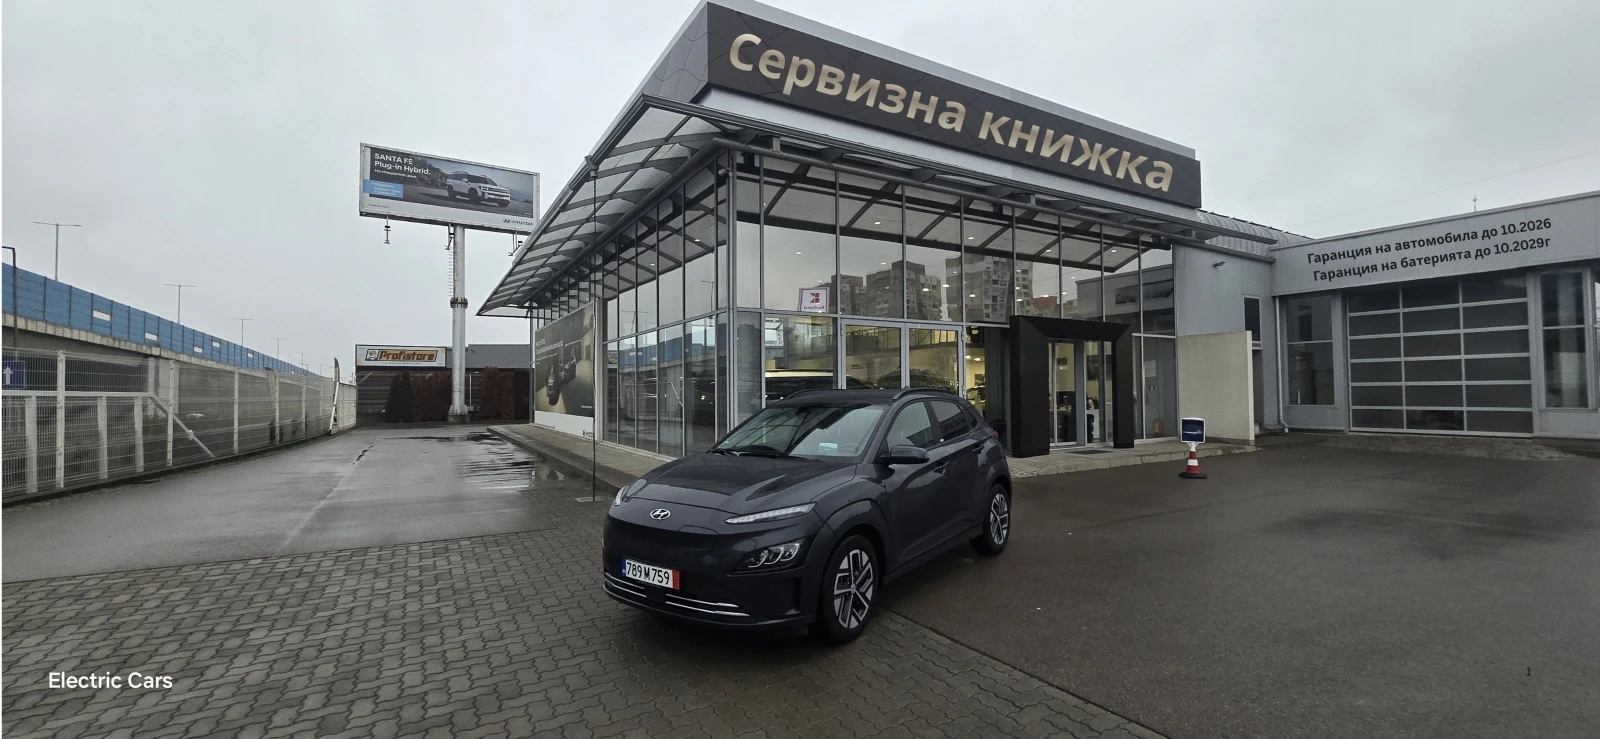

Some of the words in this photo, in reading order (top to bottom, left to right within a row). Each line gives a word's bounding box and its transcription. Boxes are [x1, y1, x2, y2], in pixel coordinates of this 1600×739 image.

[374, 153, 403, 164] SANTA
[403, 157, 413, 165] FE
[374, 160, 402, 171] Plug-in
[403, 165, 432, 175] Hybrid.
[379, 350, 435, 361] Profistore
